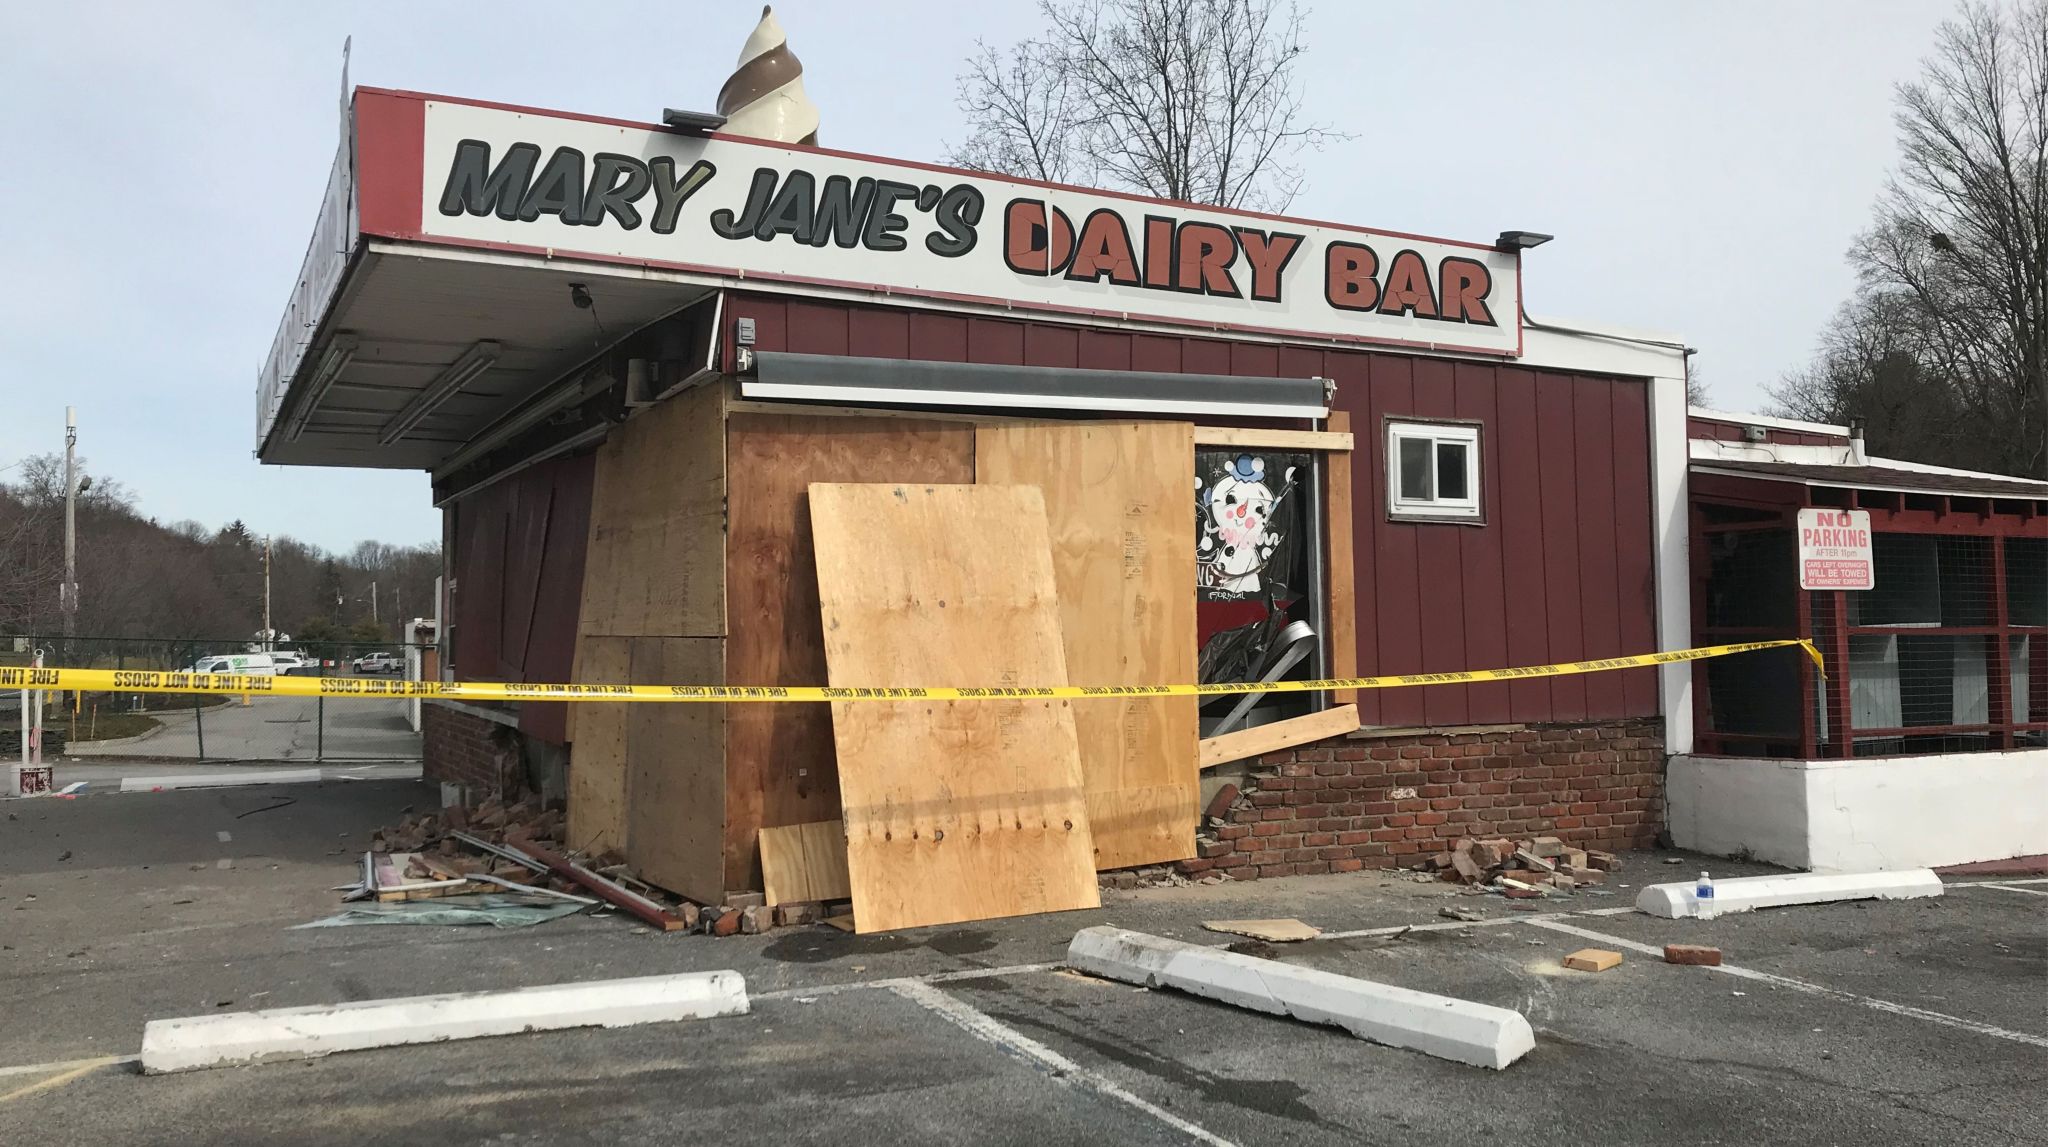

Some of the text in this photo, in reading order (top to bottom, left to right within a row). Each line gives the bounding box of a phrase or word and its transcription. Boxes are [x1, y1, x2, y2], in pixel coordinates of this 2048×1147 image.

[438, 139, 1498, 327] MARY JANE'S DAIRY BAR
[1817, 512, 1852, 527] NO
[1803, 528, 1867, 547] PARKING
[1808, 569, 1866, 578] WILL BE TOWED
[28, 670, 59, 685] FIRE
[114, 672, 272, 690] FIRE LINE DO NOT CROSS
[321, 679, 360, 692] CROSS
[364, 680, 387, 693] NOT
[391, 680, 405, 694] DO
[409, 681, 434, 694] LINE
[671, 687, 788, 697] FIRE LINE DO NOT CROSS
[957, 688, 986, 696] CROSS
[988, 688, 1004, 696] NOT
[1004, 688, 1016, 696] DO
[1018, 688, 1035, 696] LINE
[821, 688, 927, 697] FIRE LINE DO NOT CROSS
